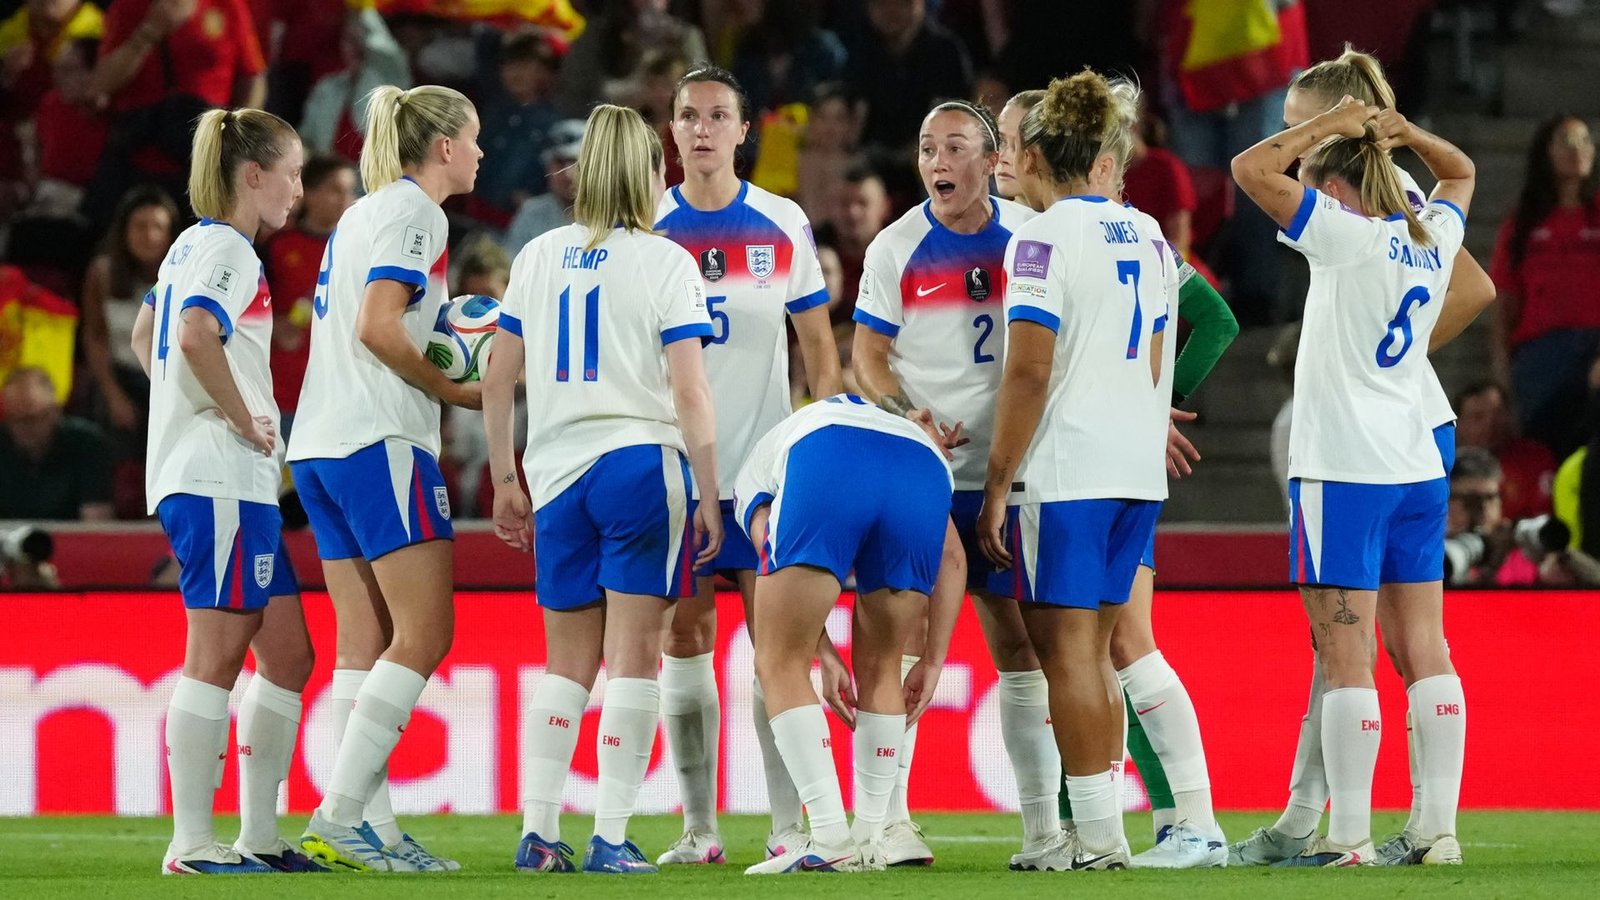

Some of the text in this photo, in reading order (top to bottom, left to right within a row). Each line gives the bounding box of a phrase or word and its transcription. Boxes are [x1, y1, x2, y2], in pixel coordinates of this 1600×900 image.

[1100, 220, 1139, 244] JAMES
[562, 246, 608, 271] HEMP
[706, 295, 730, 346] 5
[1116, 259, 1140, 360] 7
[158, 283, 173, 381] 4
[555, 284, 600, 382] 11
[1376, 285, 1431, 368] 6
[973, 314, 994, 364] 2
[1436, 704, 1459, 716] ENG
[549, 716, 570, 729] ENG
[1361, 719, 1380, 731] ENG
[603, 735, 621, 747] ENG
[822, 737, 832, 749] EN
[876, 747, 896, 758] ENG
